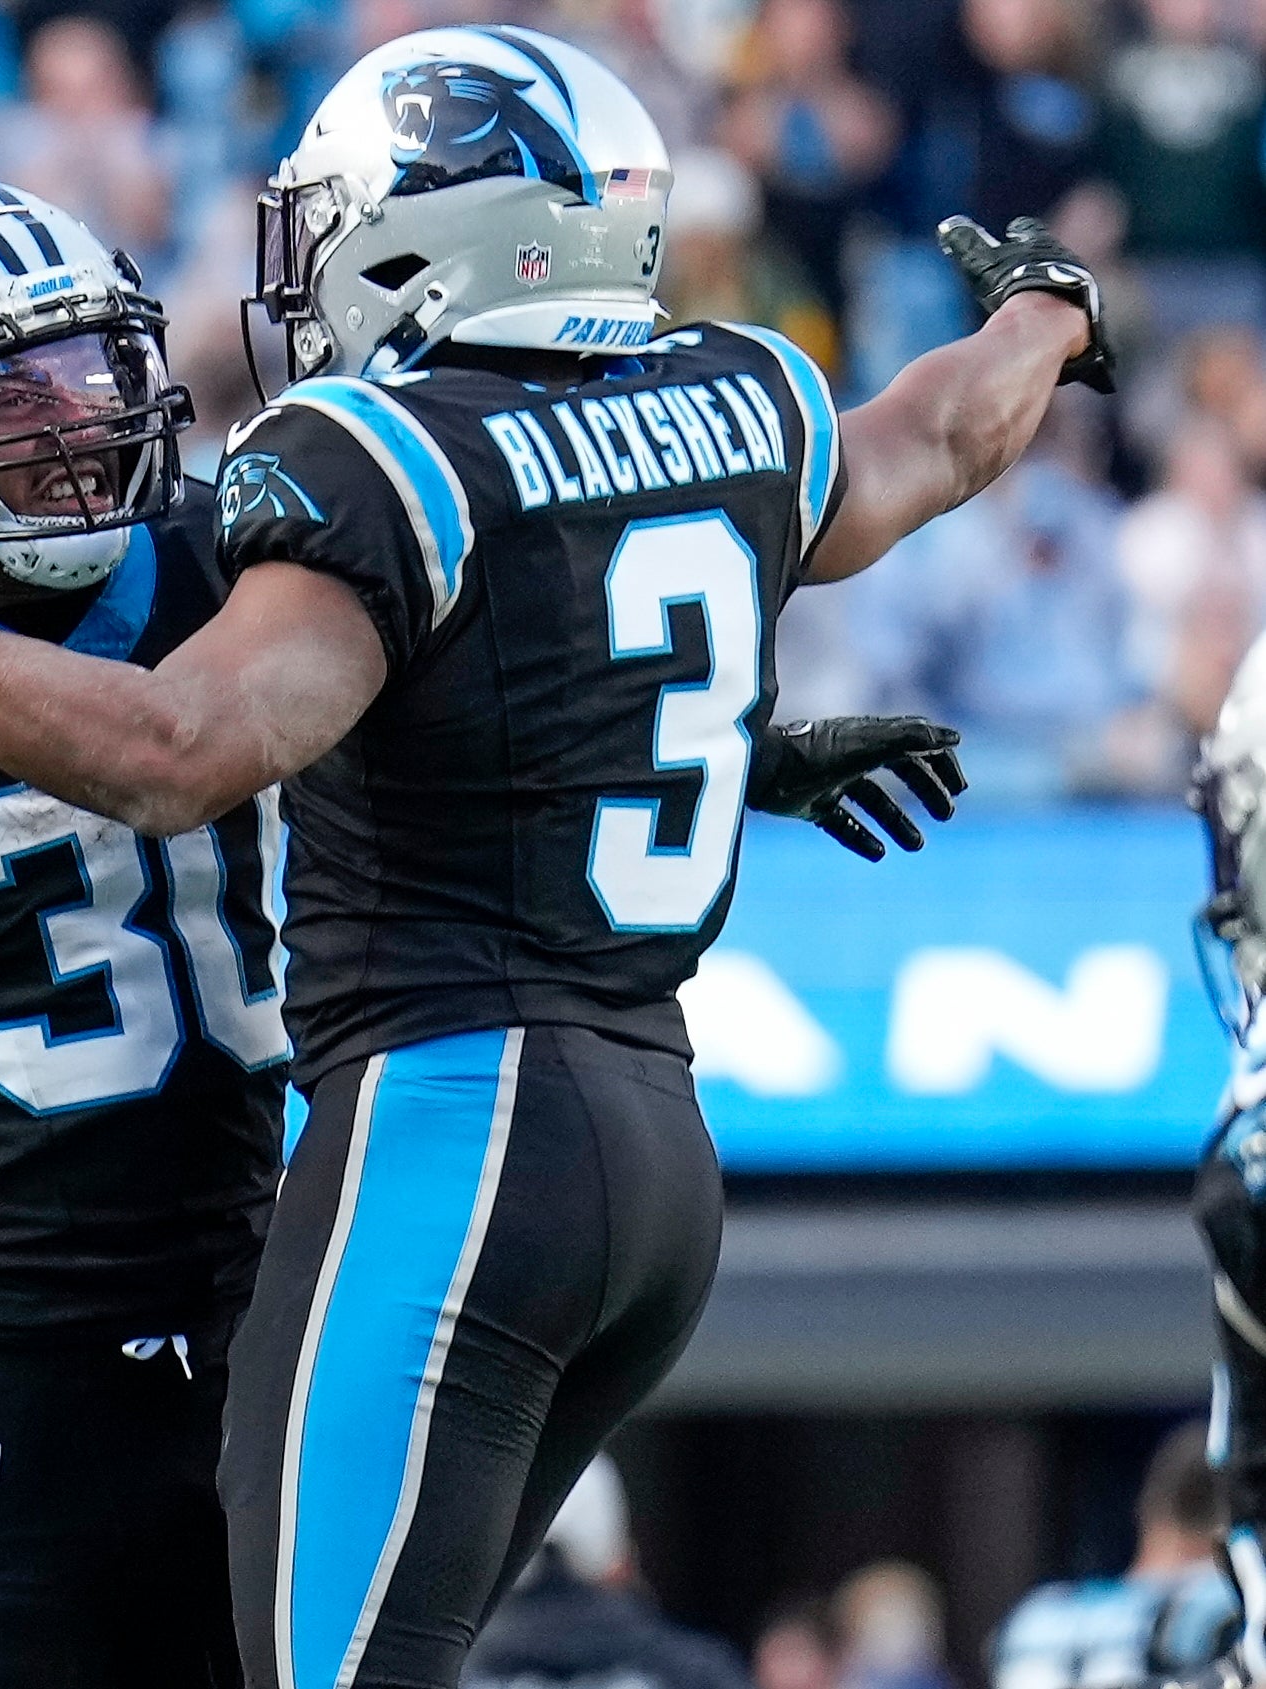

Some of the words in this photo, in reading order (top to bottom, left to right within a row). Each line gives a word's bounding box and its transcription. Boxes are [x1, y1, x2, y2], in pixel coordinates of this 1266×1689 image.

[521, 260, 547, 282] NFL
[640, 224, 661, 277] 3
[481, 373, 790, 512] BLACKSHEAR
[586, 507, 762, 933] 3
